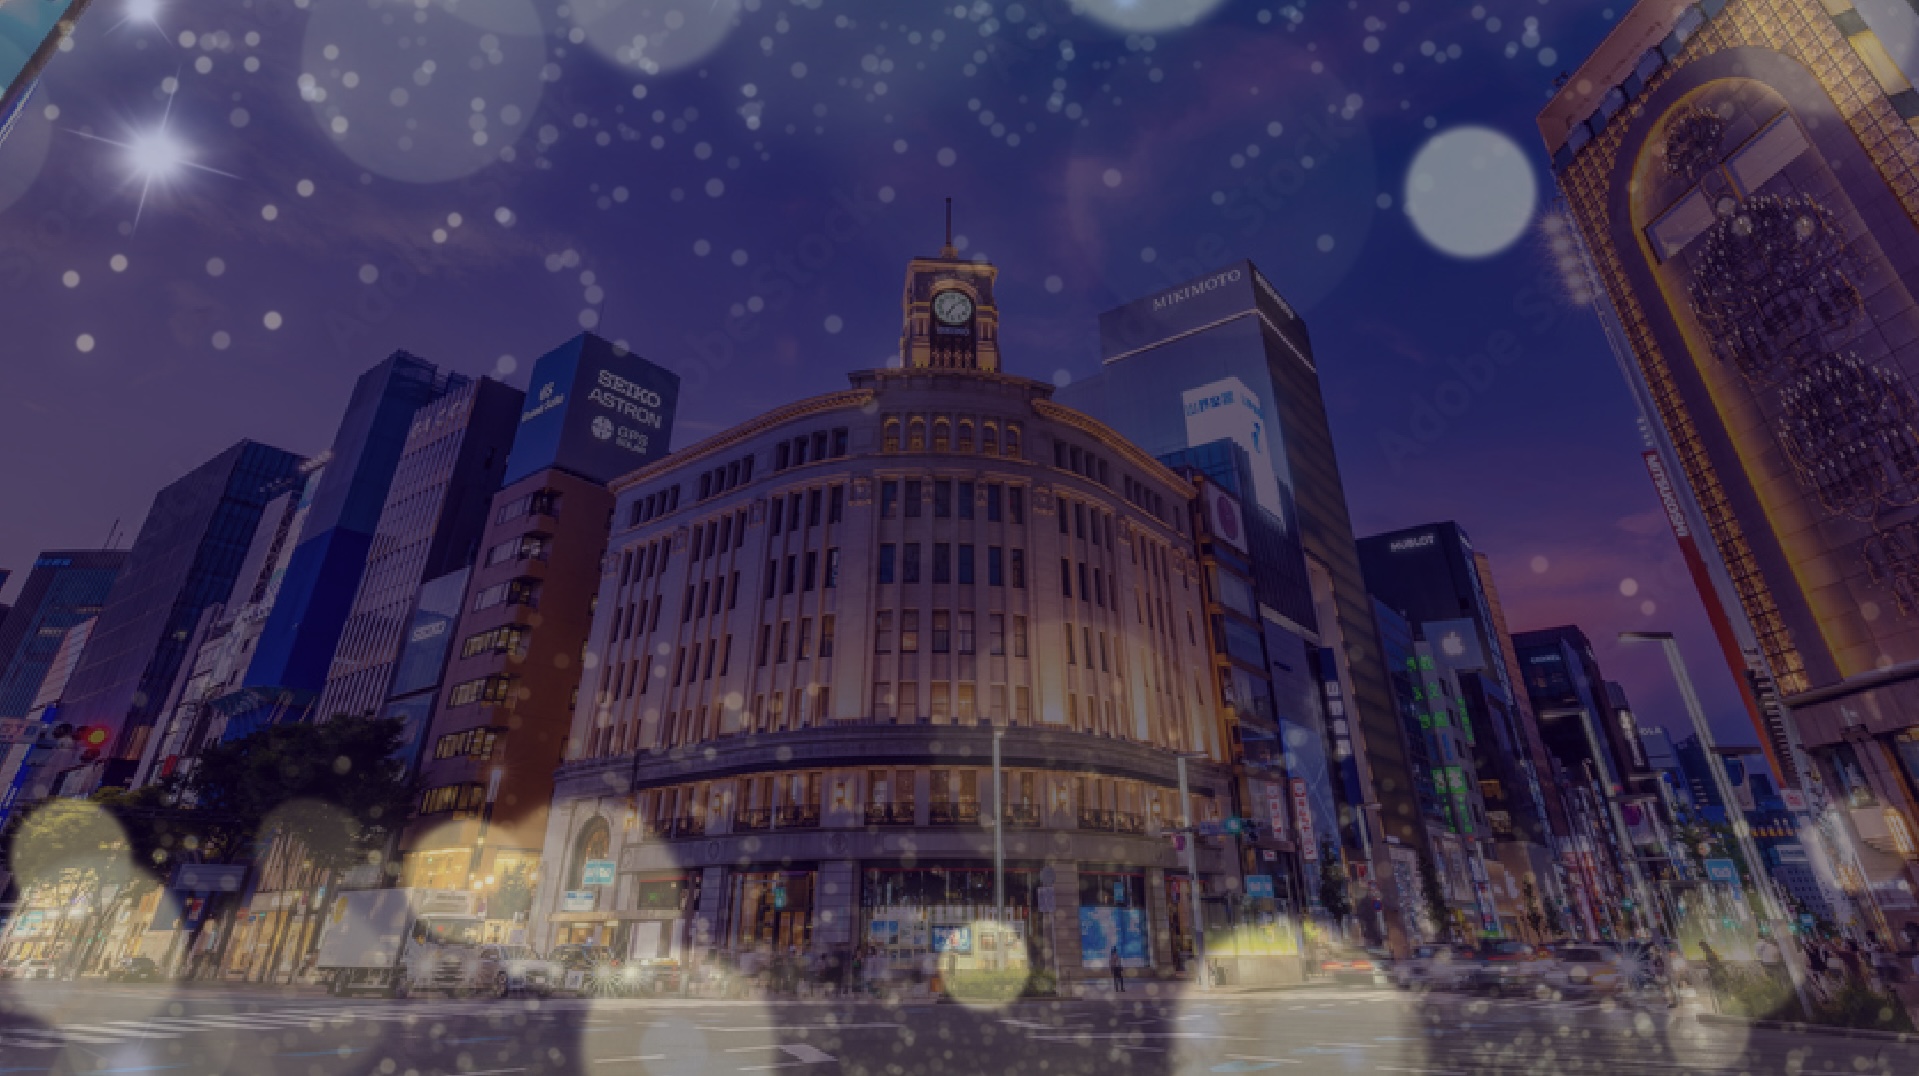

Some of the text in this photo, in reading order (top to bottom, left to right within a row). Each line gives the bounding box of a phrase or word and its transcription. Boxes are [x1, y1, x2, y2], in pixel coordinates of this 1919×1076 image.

[1152, 269, 1241, 312] MIKIMOTO
[588, 387, 662, 429] ASTRON
[598, 369, 661, 408] SEIKO
